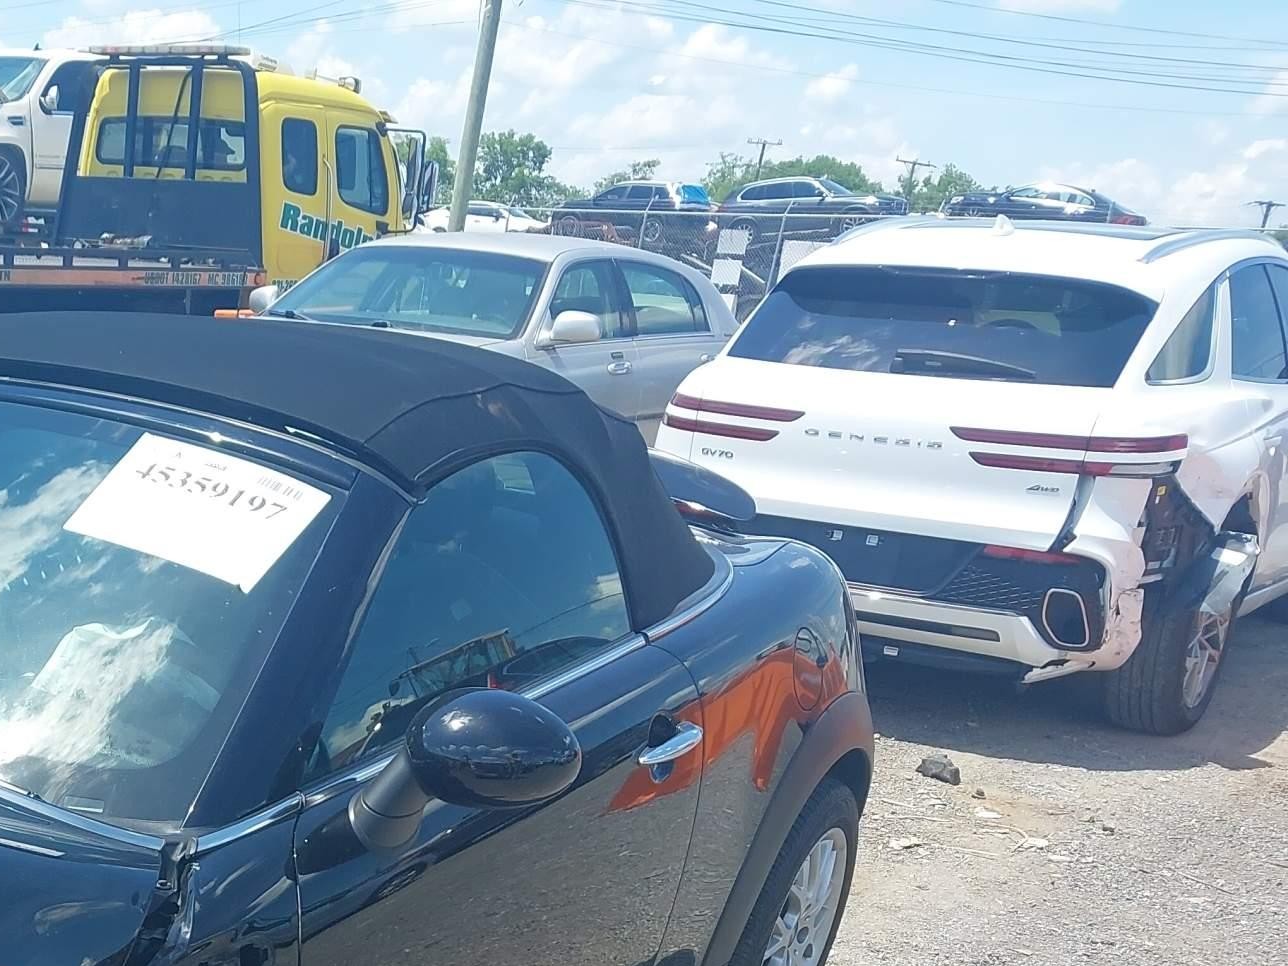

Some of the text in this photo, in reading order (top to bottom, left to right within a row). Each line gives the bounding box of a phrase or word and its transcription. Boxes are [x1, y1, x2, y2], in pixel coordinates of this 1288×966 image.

[0, 269, 11, 281] TN
[804, 428, 943, 449] GENESIS
[701, 447, 734, 459] GV70
[135, 463, 288, 520] 45359197
